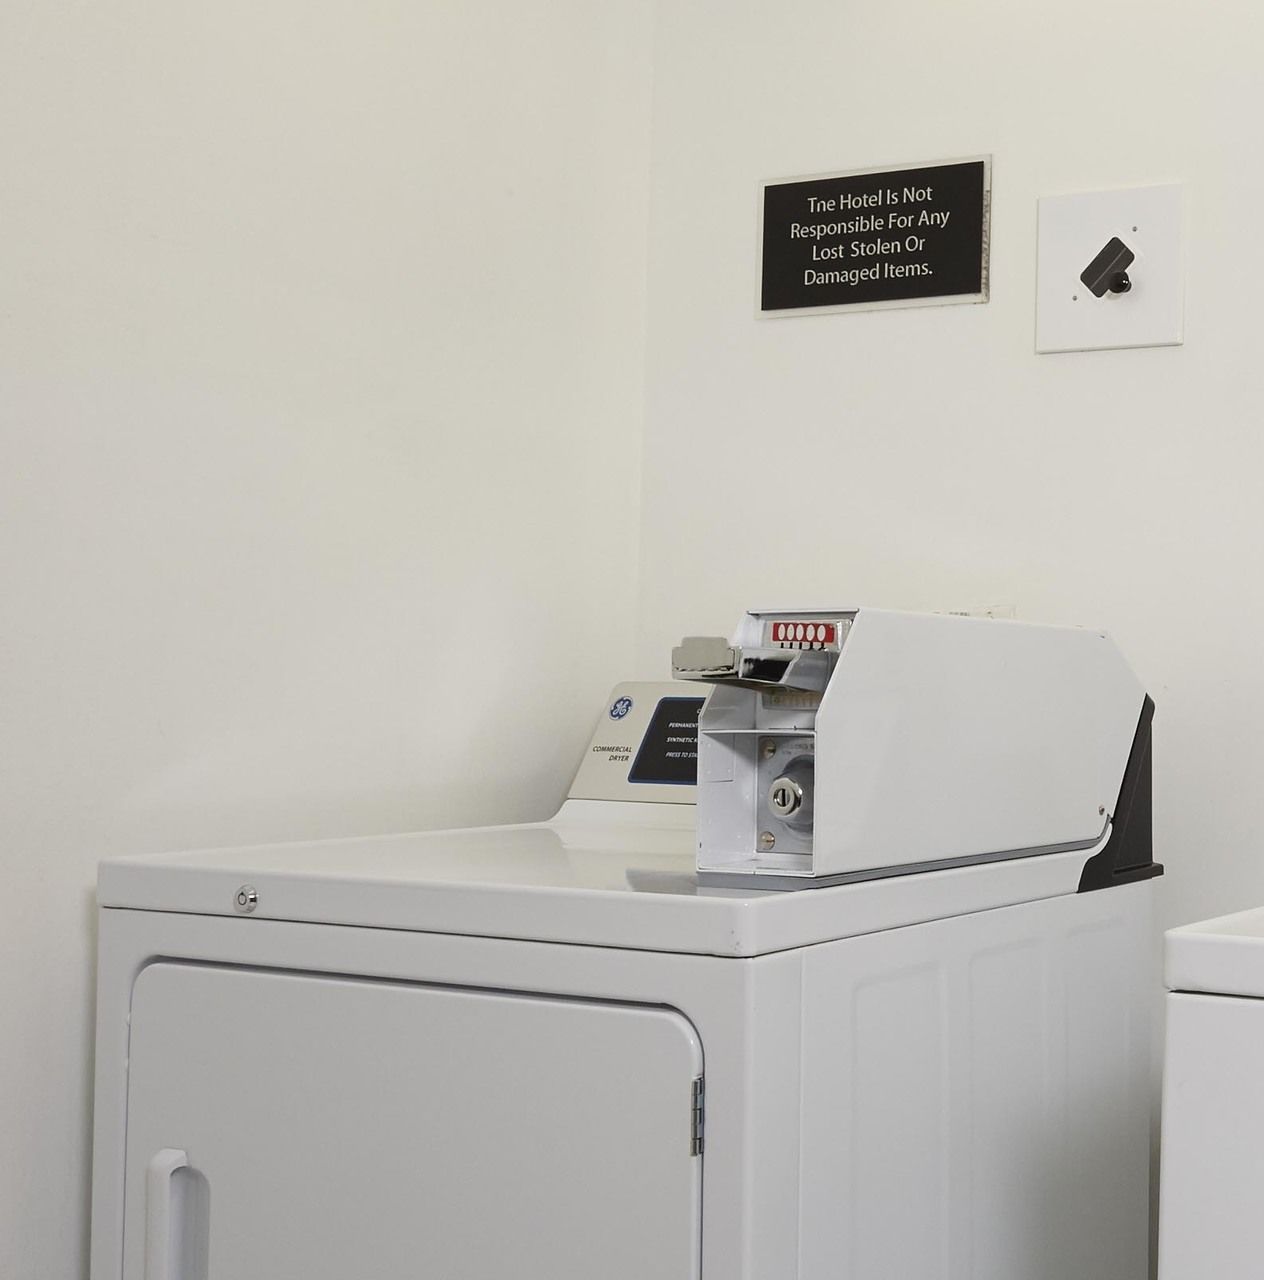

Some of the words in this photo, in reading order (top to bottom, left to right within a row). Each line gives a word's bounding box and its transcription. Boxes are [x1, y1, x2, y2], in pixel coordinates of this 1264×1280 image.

[840, 189, 882, 210] Hotel
[886, 189, 899, 205] Is
[903, 186, 933, 203] Not
[790, 215, 884, 240] Responsible
[888, 213, 914, 229] For
[918, 210, 950, 229] Any
[812, 244, 844, 261] Lost
[850, 238, 901, 258] Stolen
[905, 235, 926, 251] Or
[804, 263, 880, 286] Damaged
[884, 261, 933, 279] Items.
